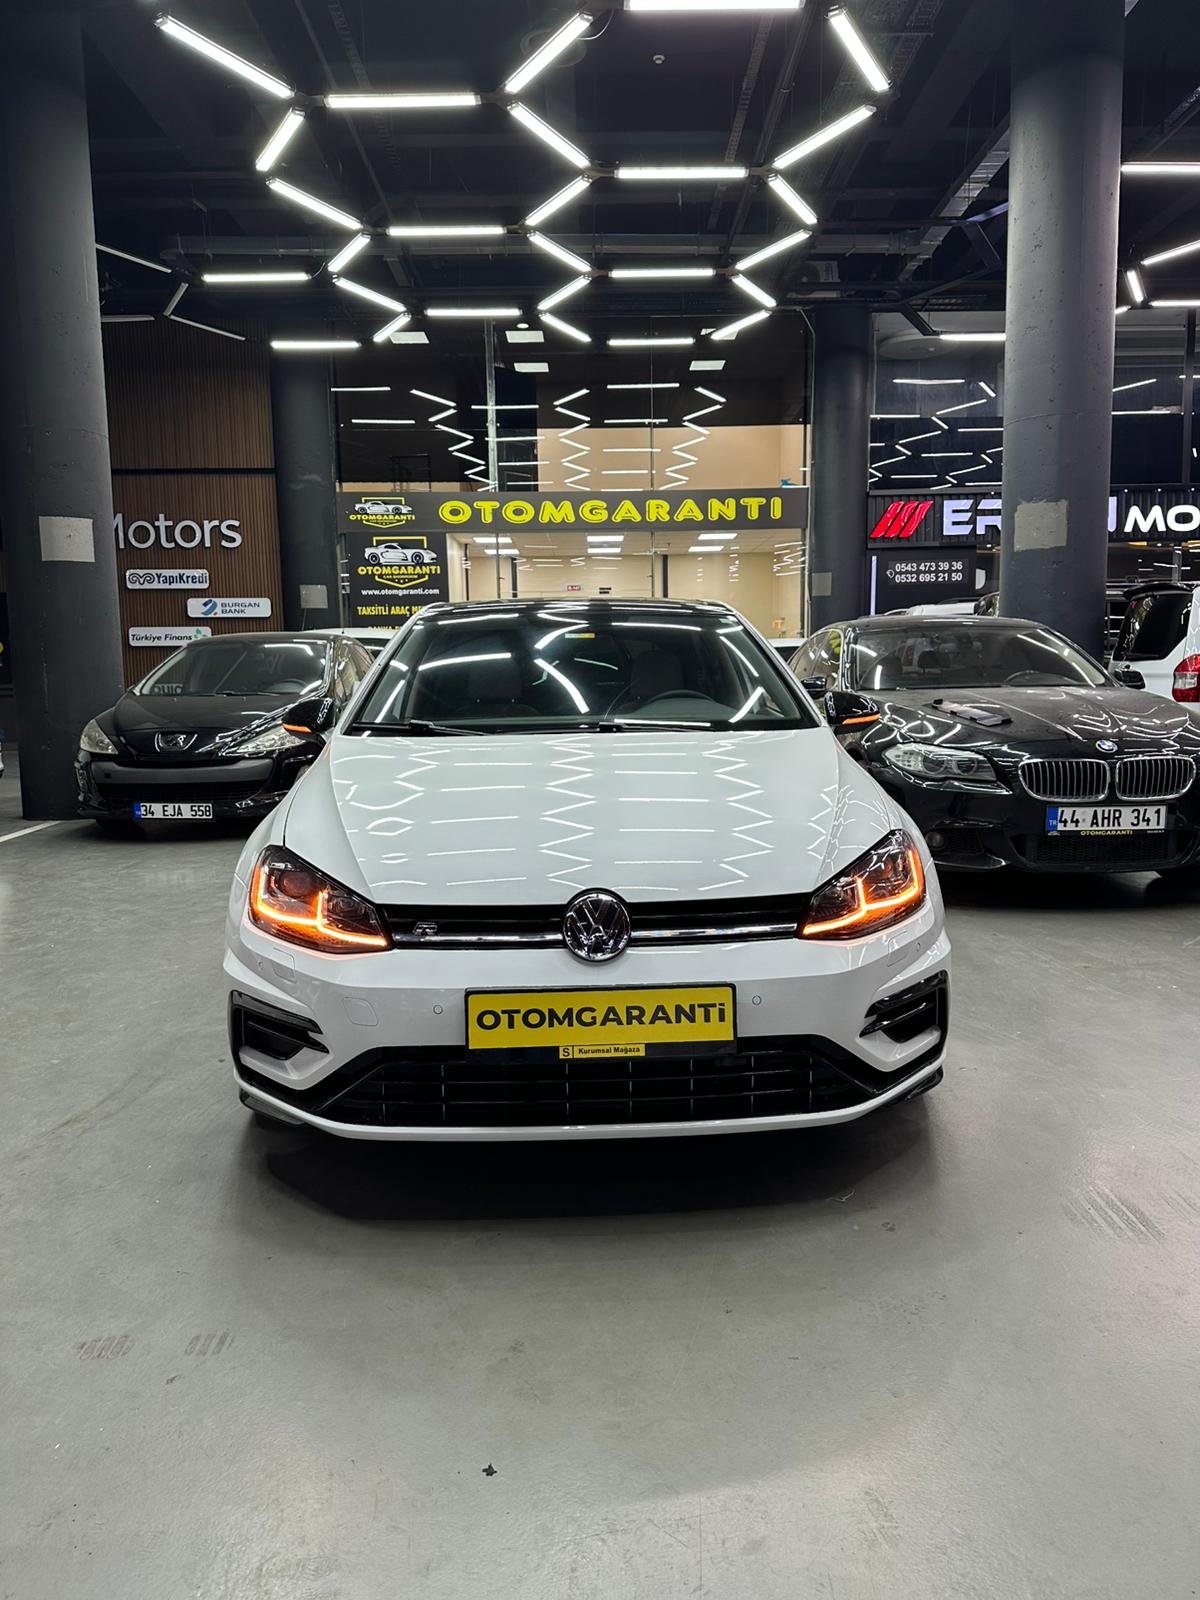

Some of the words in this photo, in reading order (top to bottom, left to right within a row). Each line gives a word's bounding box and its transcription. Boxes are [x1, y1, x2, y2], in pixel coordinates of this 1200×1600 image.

[438, 497, 783, 524] OTOMGARANTI
[357, 565, 441, 575] OTOMGARANTI
[895, 562, 917, 572] 0543
[919, 562, 936, 571] 473
[938, 561, 950, 571] 39
[951, 561, 963, 570] 36
[895, 573, 917, 583] 0532
[919, 573, 936, 582] 695
[938, 573, 949, 582] 21
[951, 572, 963, 581] 50
[360, 588, 440, 596] www.otomgaranti.com
[356, 603, 389, 615] TAKSİTLİ
[390, 605, 410, 617] ARAÇ
[130, 633, 162, 643] Türkiye
[164, 633, 193, 641] Finans
[141, 804, 155, 817] 34
[162, 804, 183, 817] EJA
[190, 804, 212, 817] 558
[1058, 809, 1080, 828] 44
[1090, 808, 1122, 828] AHR
[1130, 807, 1161, 827] 341
[578, 1047, 612, 1055] Kurumsal
[613, 1046, 640, 1055] Mağaza
